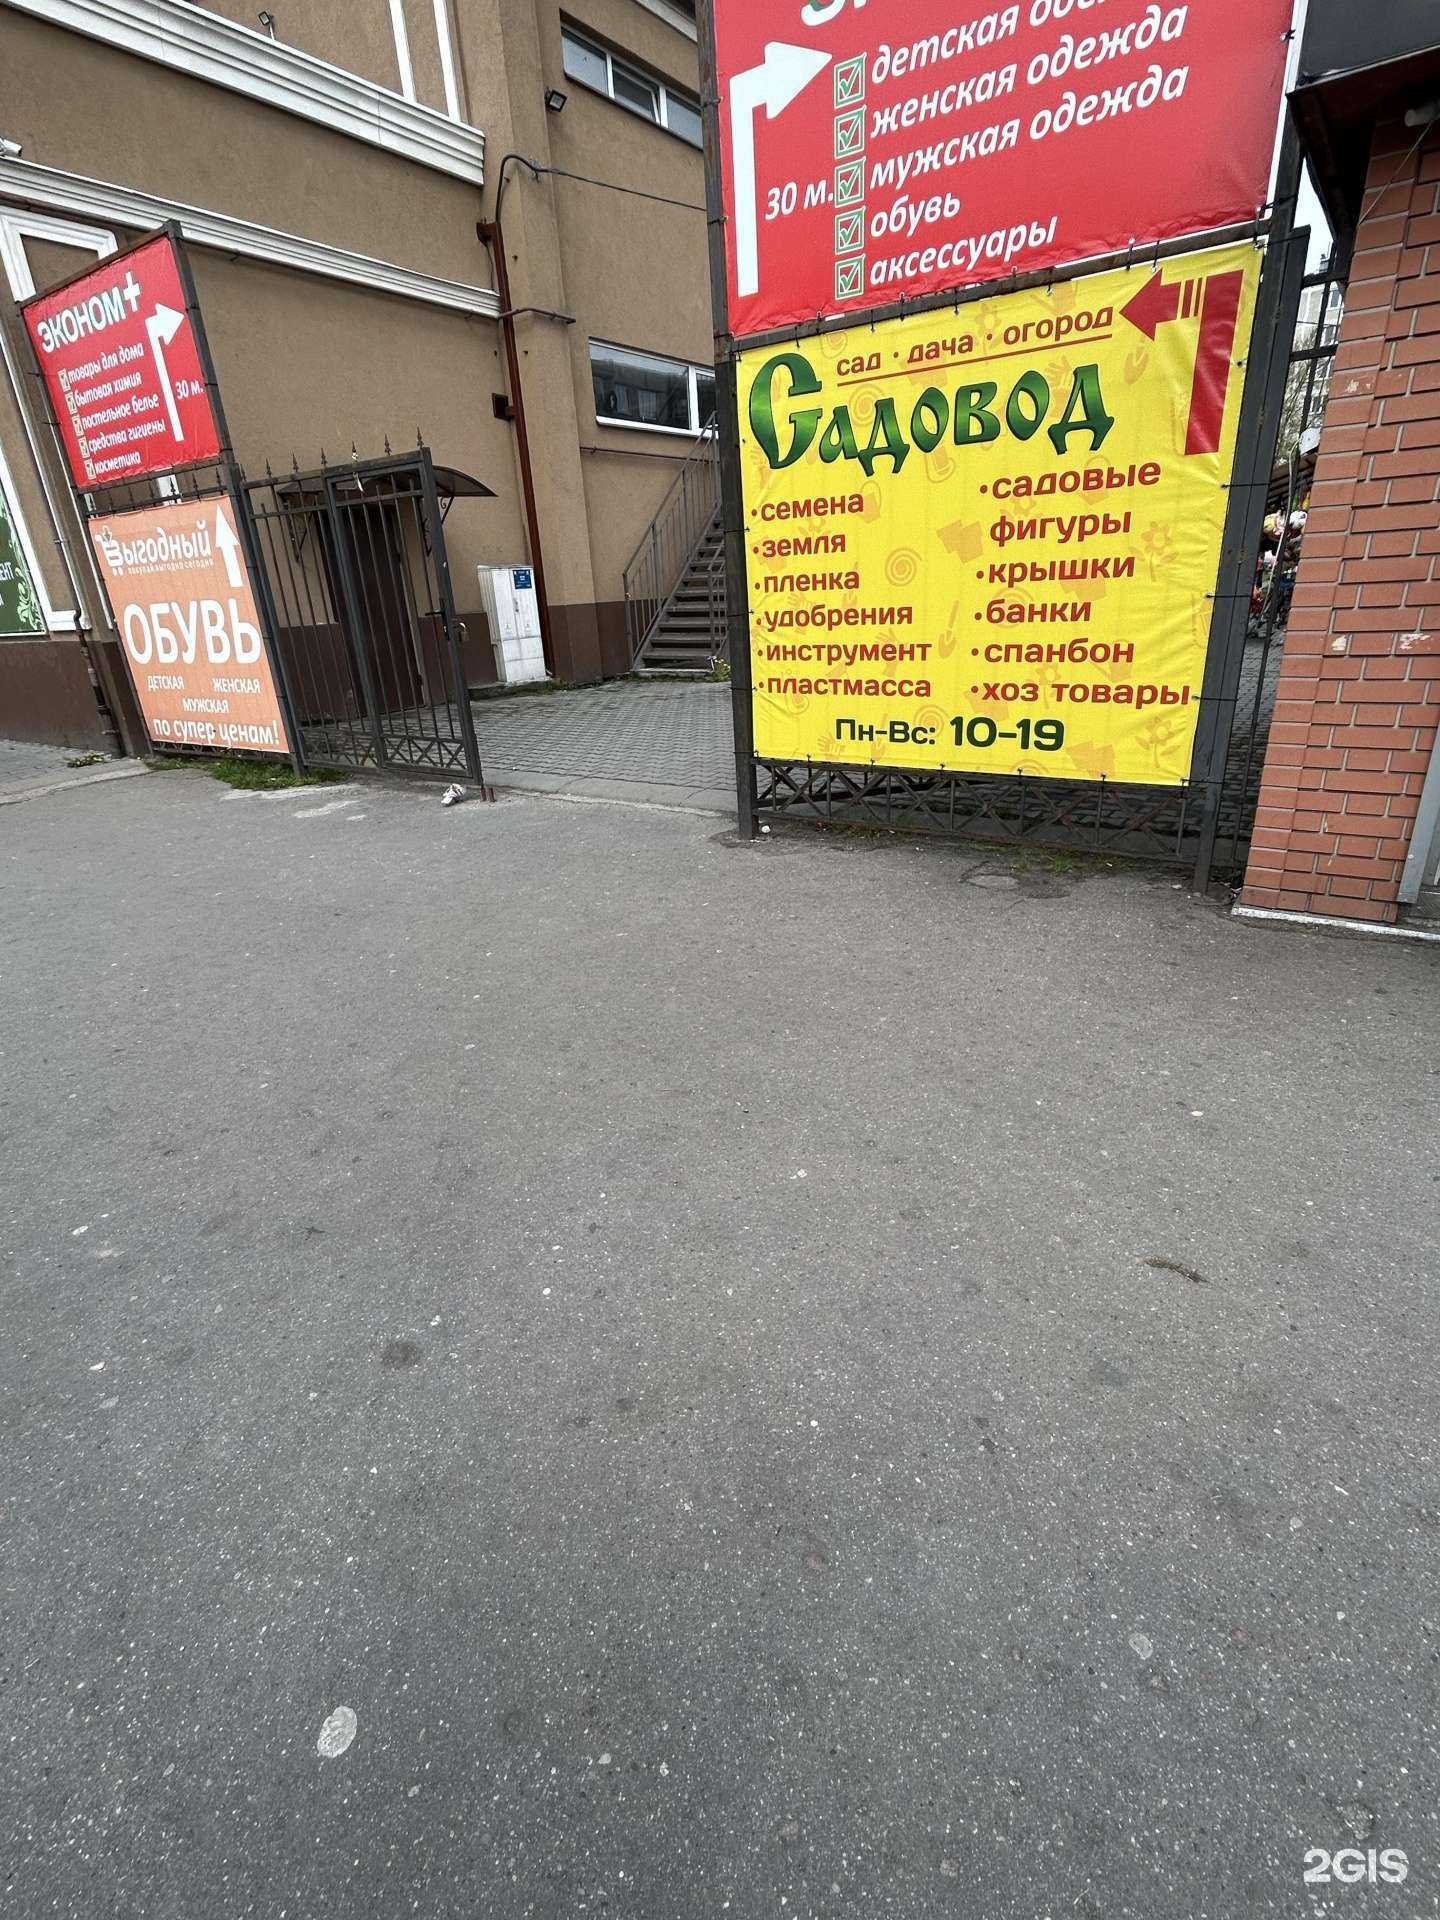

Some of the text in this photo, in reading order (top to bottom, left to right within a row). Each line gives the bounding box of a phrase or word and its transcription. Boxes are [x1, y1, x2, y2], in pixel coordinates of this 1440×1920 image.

[872, 5, 1021, 84] детская
[871, 4, 1188, 139] женская одежда
[870, 64, 1190, 190] мужская одежда
[765, 179, 835, 221] 30 м.
[871, 189, 961, 238] обувь
[870, 216, 1058, 286] аксессуары
[836, 305, 1113, 377] сад дача огород
[68, 343, 144, 384] товары для дома
[74, 371, 142, 407] бытовая химия
[175, 380, 205, 400] 30 м.
[81, 394, 159, 430] постельное белье
[88, 419, 166, 455] средства гигиены
[94, 451, 141, 475] косметика
[992, 461, 1161, 500] садовые
[760, 492, 864, 522] семена
[762, 530, 846, 558] земля
[990, 511, 1132, 547] фигуры
[764, 569, 860, 593] пленка
[988, 556, 1135, 588] крышки
[765, 605, 913, 632] удобрения
[986, 601, 1092, 624] банки
[123, 598, 261, 664] ОБУВЬ
[766, 641, 932, 666] инструмент
[984, 638, 1135, 664] спанбон
[147, 675, 261, 693] ДЕТСКАЯ ЖЕНСКАЯ
[767, 675, 931, 698] пластмасса
[982, 682, 1190, 710] хоз товары
[182, 698, 229, 713] МУЖСКАЯ
[153, 718, 279, 748] по супер ценам!
[835, 716, 1065, 752] Пн-Вс: 10-19
